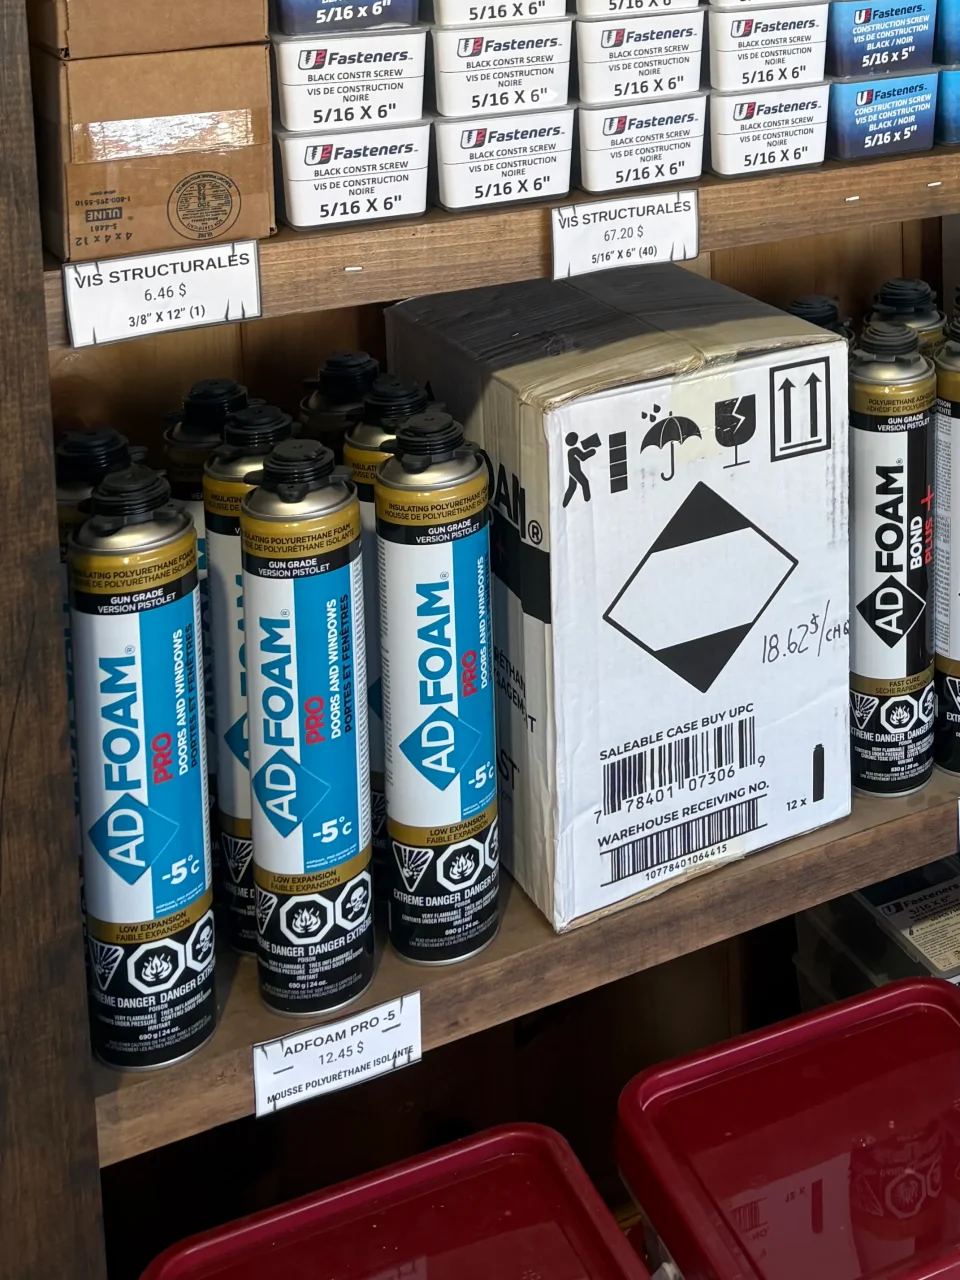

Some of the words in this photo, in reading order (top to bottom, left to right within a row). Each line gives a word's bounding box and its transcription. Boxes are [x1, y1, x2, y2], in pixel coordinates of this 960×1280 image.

[316, 6, 353, 23] 5/16
[358, 5, 367, 17] x
[372, 0, 392, 14] 6"
[314, 166, 340, 177] BLACK
[342, 163, 377, 174] CONSTR
[379, 161, 408, 170] SCREW
[314, 182, 327, 190] VIS
[329, 180, 340, 189] DE
[342, 174, 409, 188] CONSTRUCTION
[348, 186, 375, 196] NOIRE
[86, 207, 122, 220] ULINE
[320, 199, 360, 218] 5/16
[366, 198, 377, 212] X
[383, 195, 402, 210] 6"
[558, 216, 578, 229] VIS
[583, 201, 691, 224] STRUCTURALES
[604, 227, 633, 241] 67.20
[637, 225, 643, 238] $
[618, 250, 623, 259] X
[639, 246, 657, 258] (40)
[75, 274, 103, 288] VIS
[109, 253, 250, 283] STRUCTURALES
[145, 286, 174, 301] 6.46
[179, 283, 187, 297] $
[156, 312, 163, 322] X
[189, 305, 205, 318] (1)
[875, 465, 904, 635] ADFOAM
[910, 516, 922, 570] BOND
[925, 517, 933, 564] PLUS
[98, 604, 136, 614] VERSION
[138, 592, 176, 608] PISTOLET
[111, 596, 130, 604] GUN
[133, 588, 164, 602] GRADE
[259, 616, 298, 822] ADFOAM
[600, 731, 663, 760] SALEABLE
[666, 721, 698, 741] CASE
[701, 711, 726, 728] BUY
[729, 703, 754, 719] UPC
[99, 656, 146, 867] ADFOAM
[152, 732, 174, 784] PRO
[626, 787, 674, 813] 78401
[688, 768, 736, 791] 07306
[598, 811, 679, 847] WAREHOUSE
[682, 788, 745, 816] RECEIVING
[749, 782, 769, 795] NO.
[140, 911, 186, 930] EXPANSION
[284, 1030, 346, 1057] ADFOAM
[351, 1016, 379, 1036] PRO
[383, 1010, 395, 1021] -5
[319, 1046, 354, 1065] 12.45
[356, 1041, 364, 1054] $
[267, 1085, 304, 1104] MOUSSE
[305, 1061, 371, 1091] POLYURÉTHANE
[373, 1045, 414, 1067] ISOLANTE
